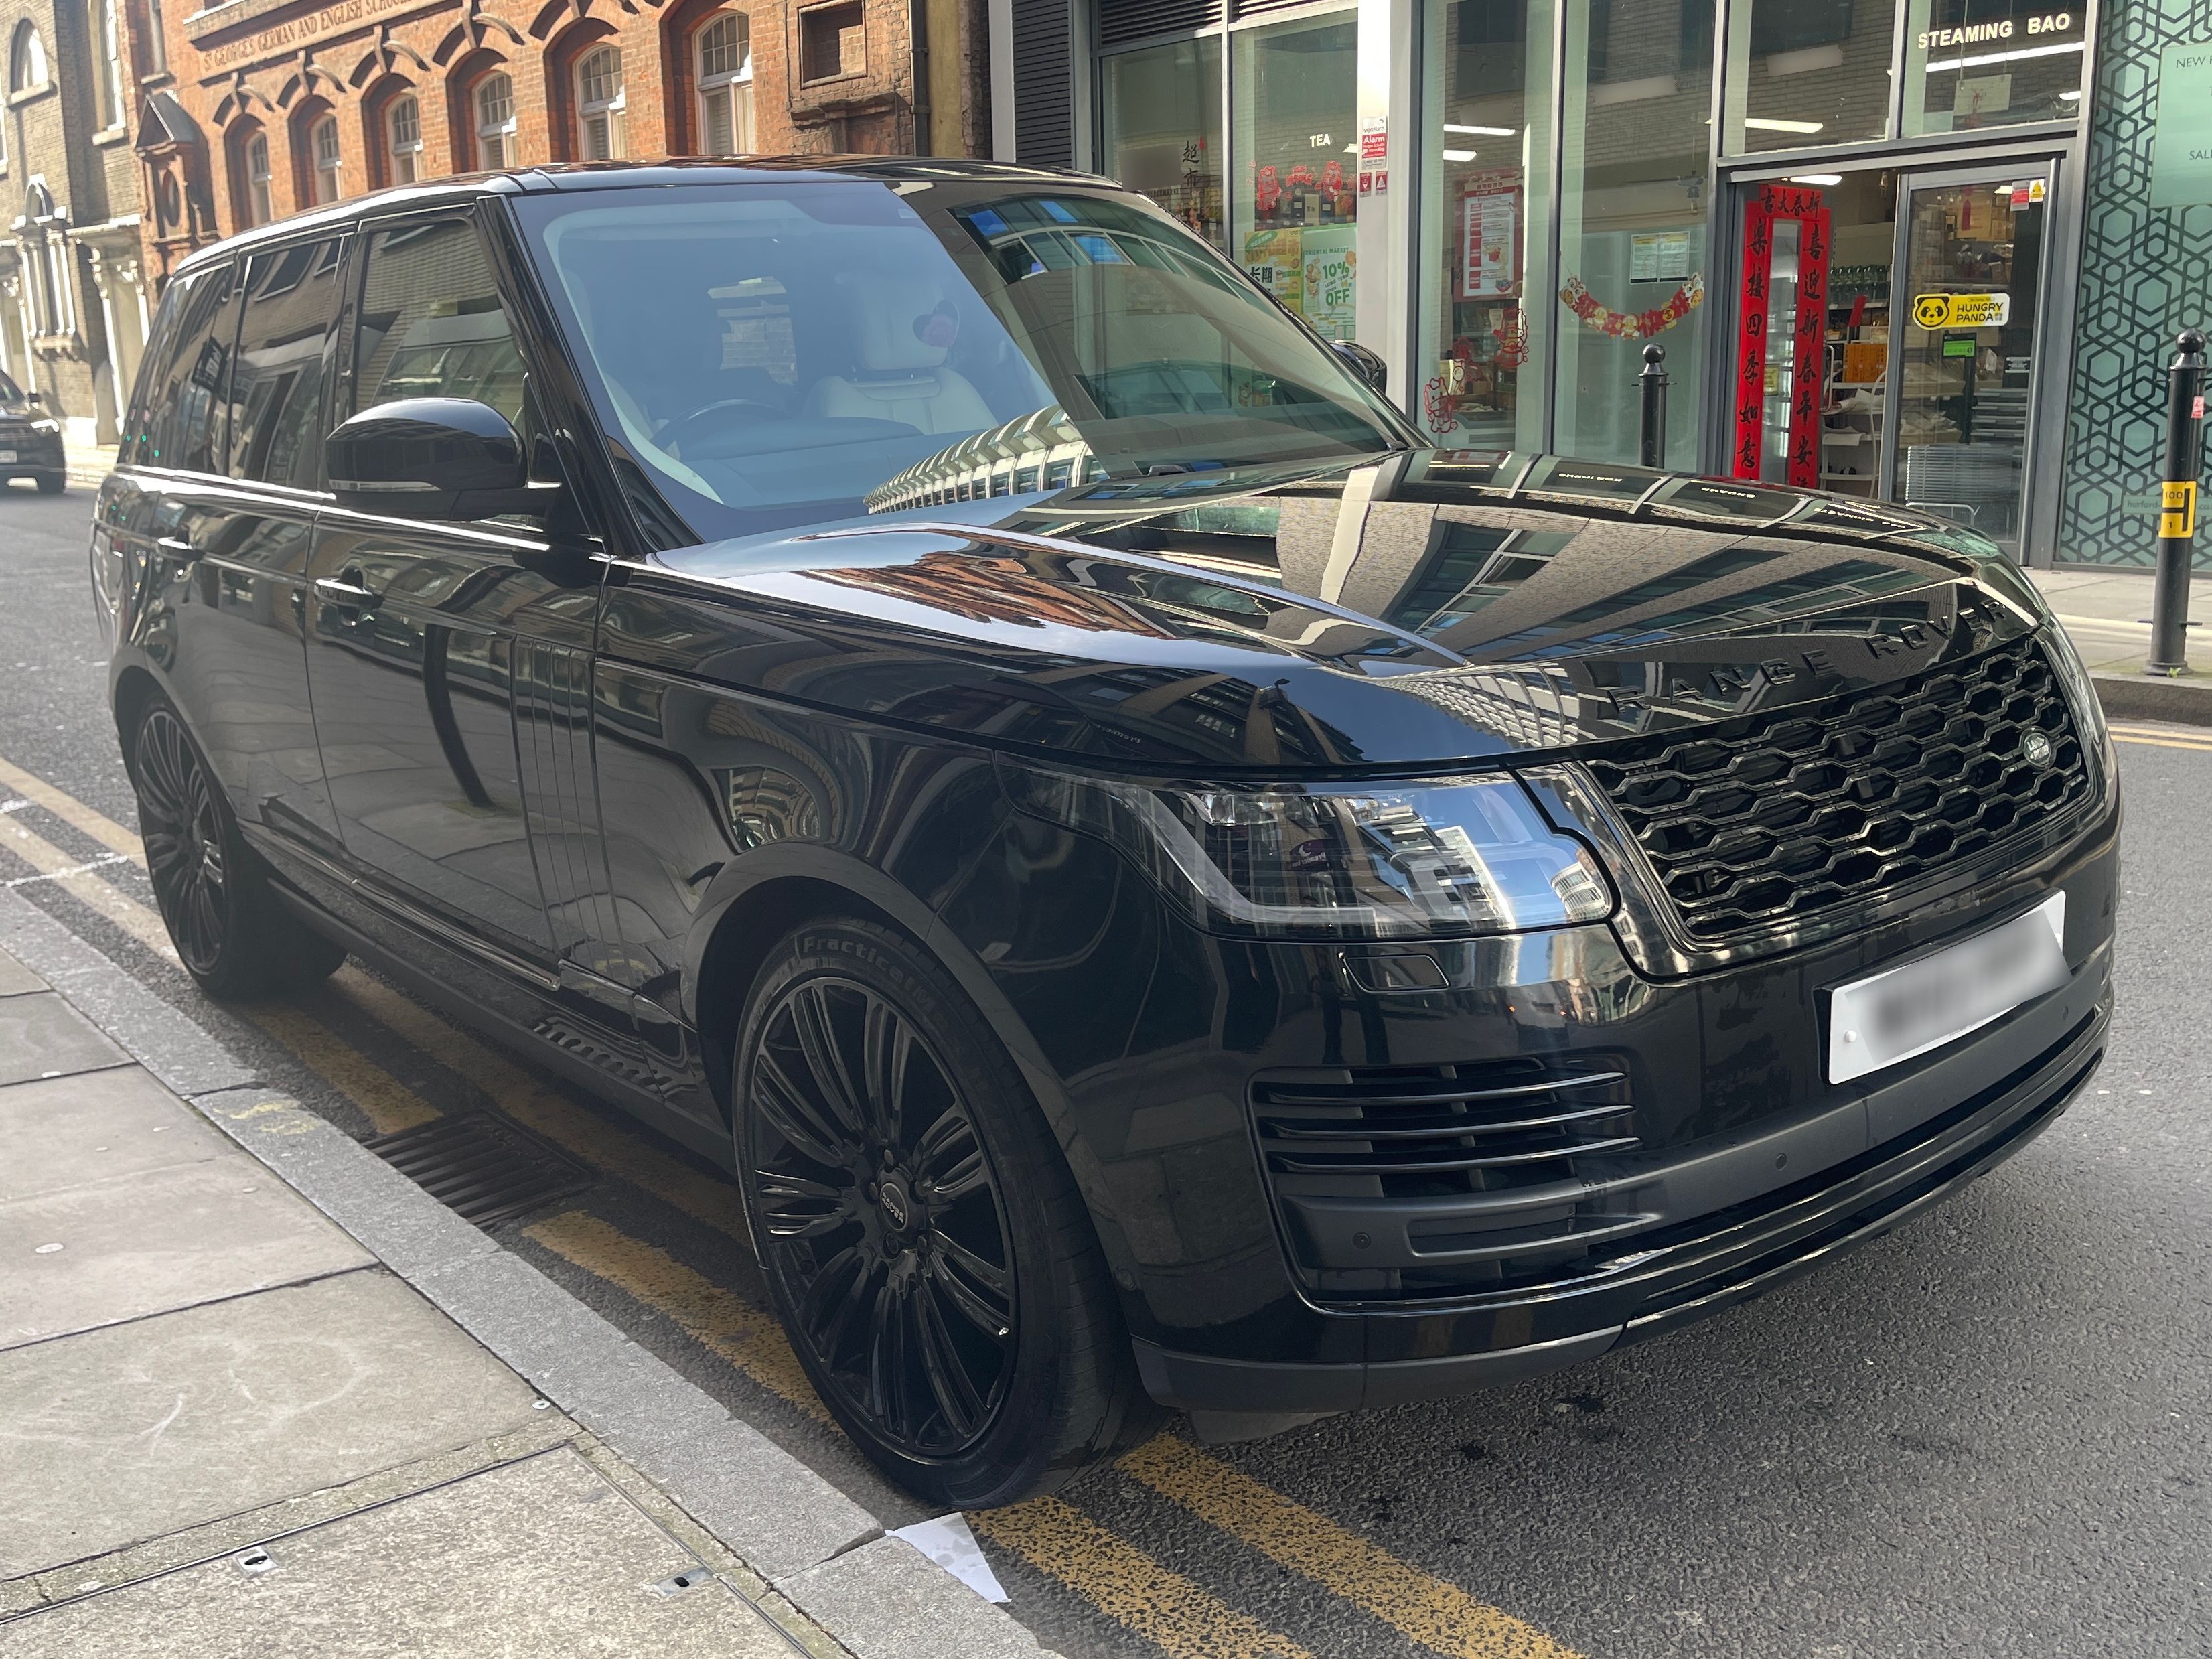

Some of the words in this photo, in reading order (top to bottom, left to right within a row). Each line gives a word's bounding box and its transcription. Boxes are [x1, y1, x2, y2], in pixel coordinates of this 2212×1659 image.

[298, 16, 317, 40] AND
[320, 0, 362, 31] ENGLISH
[1918, 21, 2013, 49] STEAMING
[2027, 13, 2071, 35] BAO
[2176, 55, 2207, 68] NEW
[1309, 133, 1331, 147] TEA
[1363, 135, 1385, 144] Alarm
[2189, 149, 2212, 161] SAL
[1323, 261, 1350, 279] 10%
[1326, 288, 1350, 306] OFF
[1957, 302, 2004, 313] HUNGRY
[1956, 313, 1994, 322] PANDA
[2165, 491, 2183, 499] 100
[2168, 521, 2173, 529] 1
[1608, 648, 1836, 714] RANGE
[1865, 601, 2006, 659] ROVER
